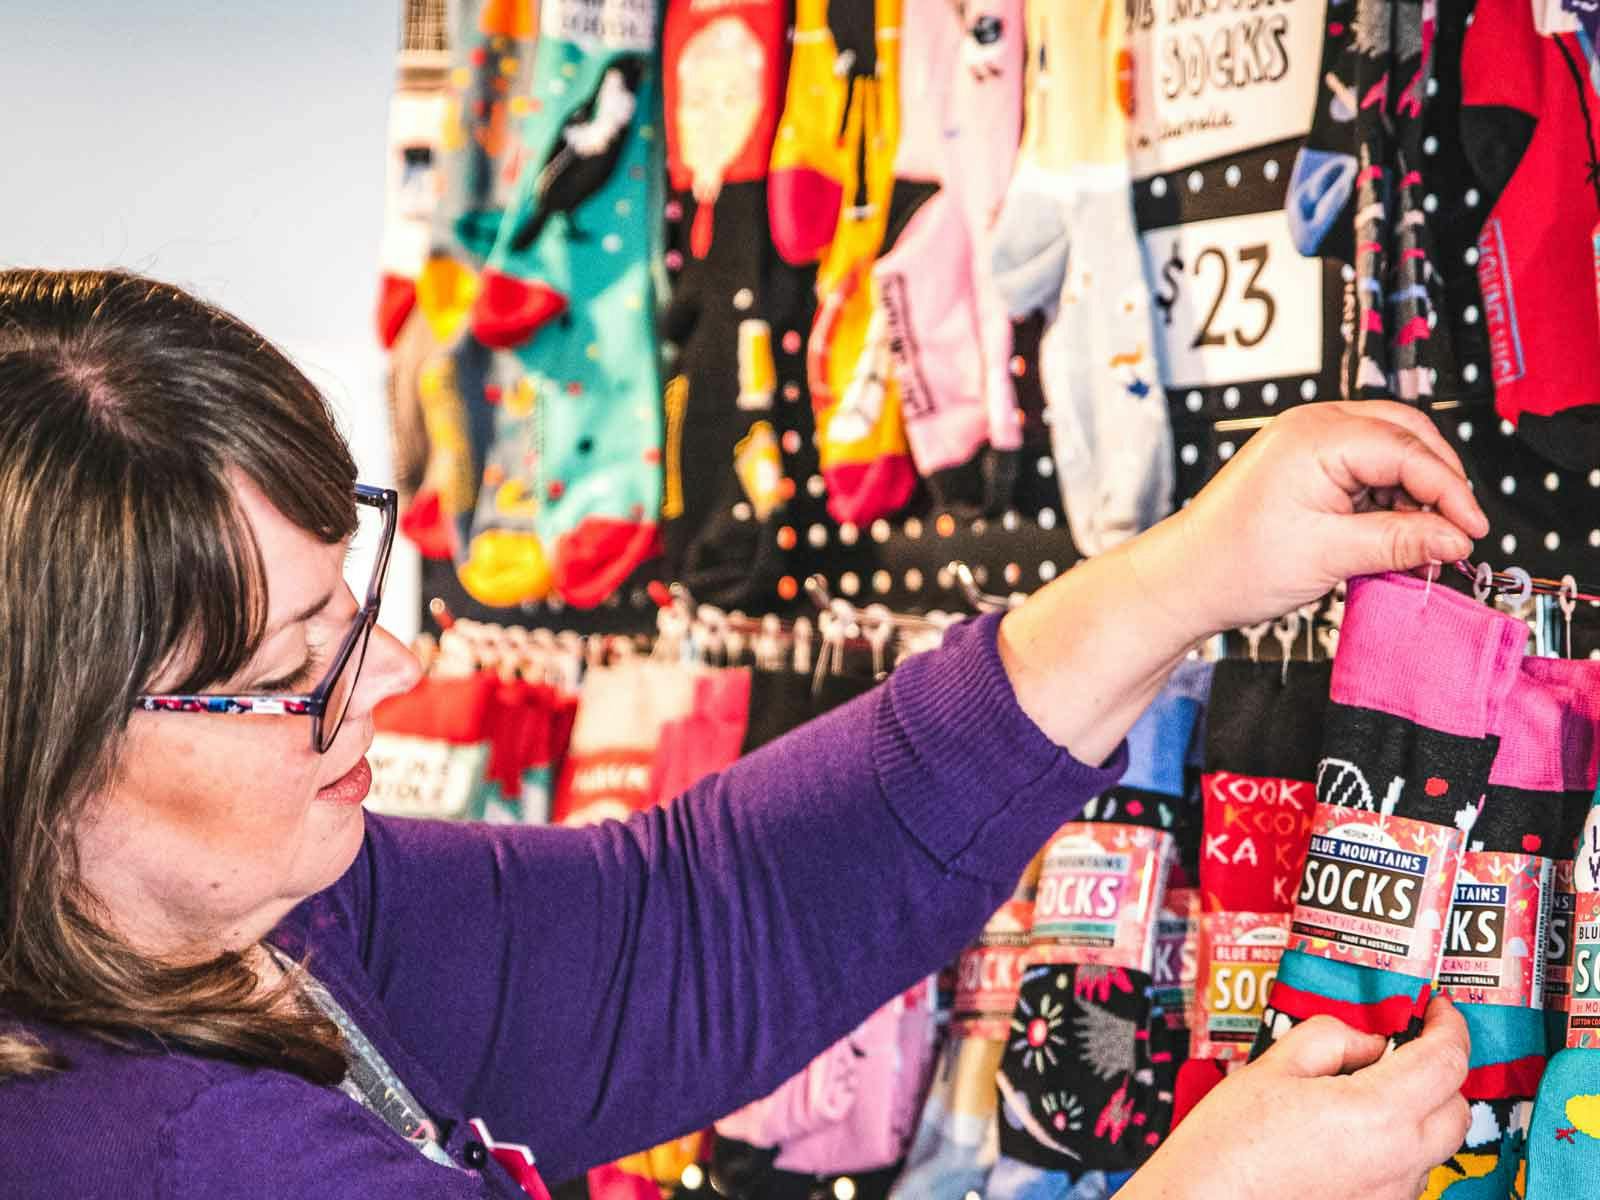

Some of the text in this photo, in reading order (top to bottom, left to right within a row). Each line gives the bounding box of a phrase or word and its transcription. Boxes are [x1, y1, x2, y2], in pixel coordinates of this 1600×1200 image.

[1163, 15, 1288, 99] SOCKS
[1311, 836, 1421, 871] BLUE MOUNTAINS
[1300, 860, 1416, 921] SOCKS
[1341, 932, 1359, 944] MADE
[1367, 937, 1405, 954] AUSTRALIA
[1361, 921, 1381, 934] AND
[1385, 927, 1401, 937] ME
[1450, 910, 1498, 953] KS
[1537, 915, 1545, 949] WESTERN
[1450, 960, 1470, 971] AND
[1475, 960, 1489, 972] ME
[1460, 975, 1496, 985] AUSTRALIA
[1585, 1002, 1600, 1014] MO
